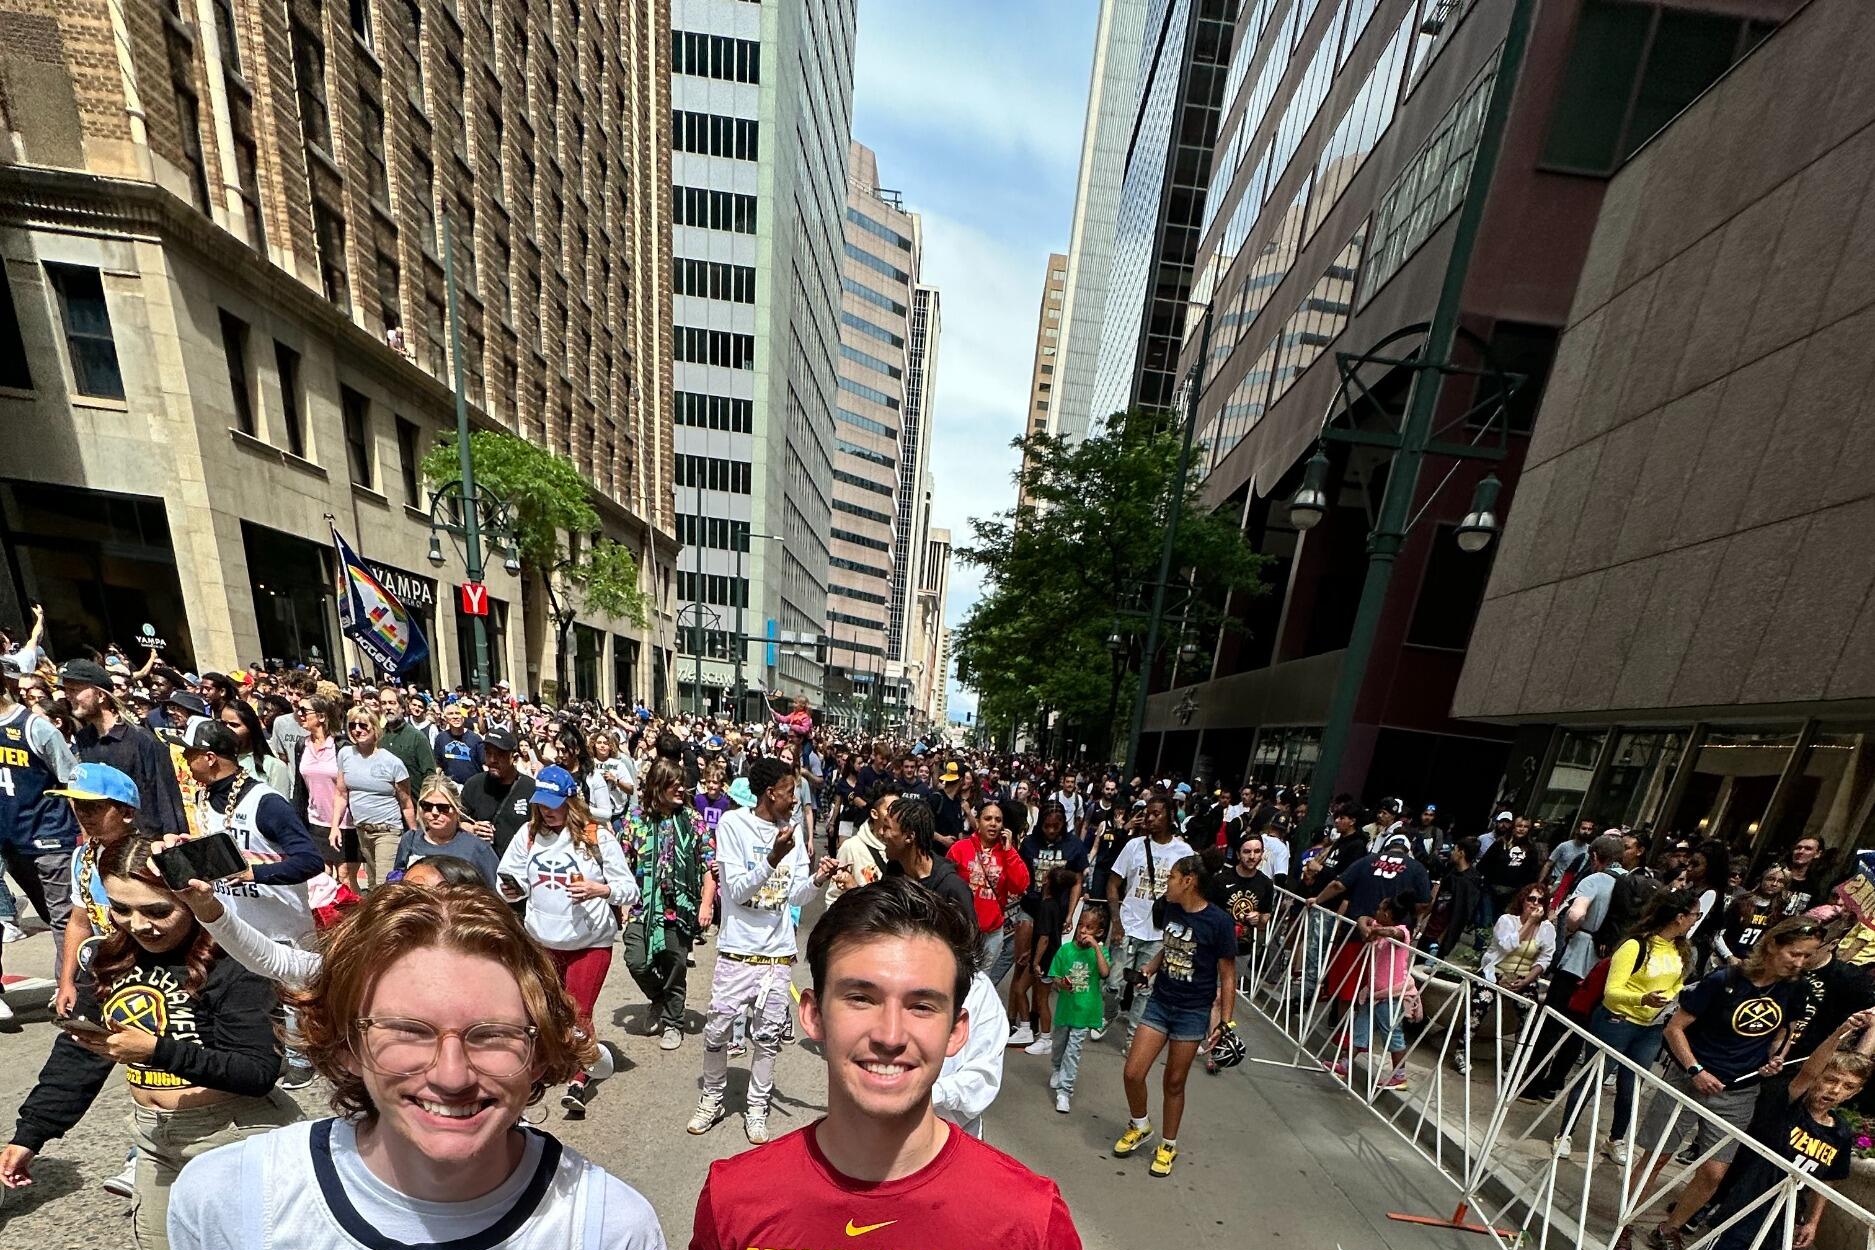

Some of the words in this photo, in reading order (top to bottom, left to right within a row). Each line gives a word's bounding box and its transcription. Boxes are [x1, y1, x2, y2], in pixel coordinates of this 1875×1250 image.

[372, 568, 433, 605] YAMPA
[465, 585, 483, 613] Y
[1738, 927, 1763, 946] 27
